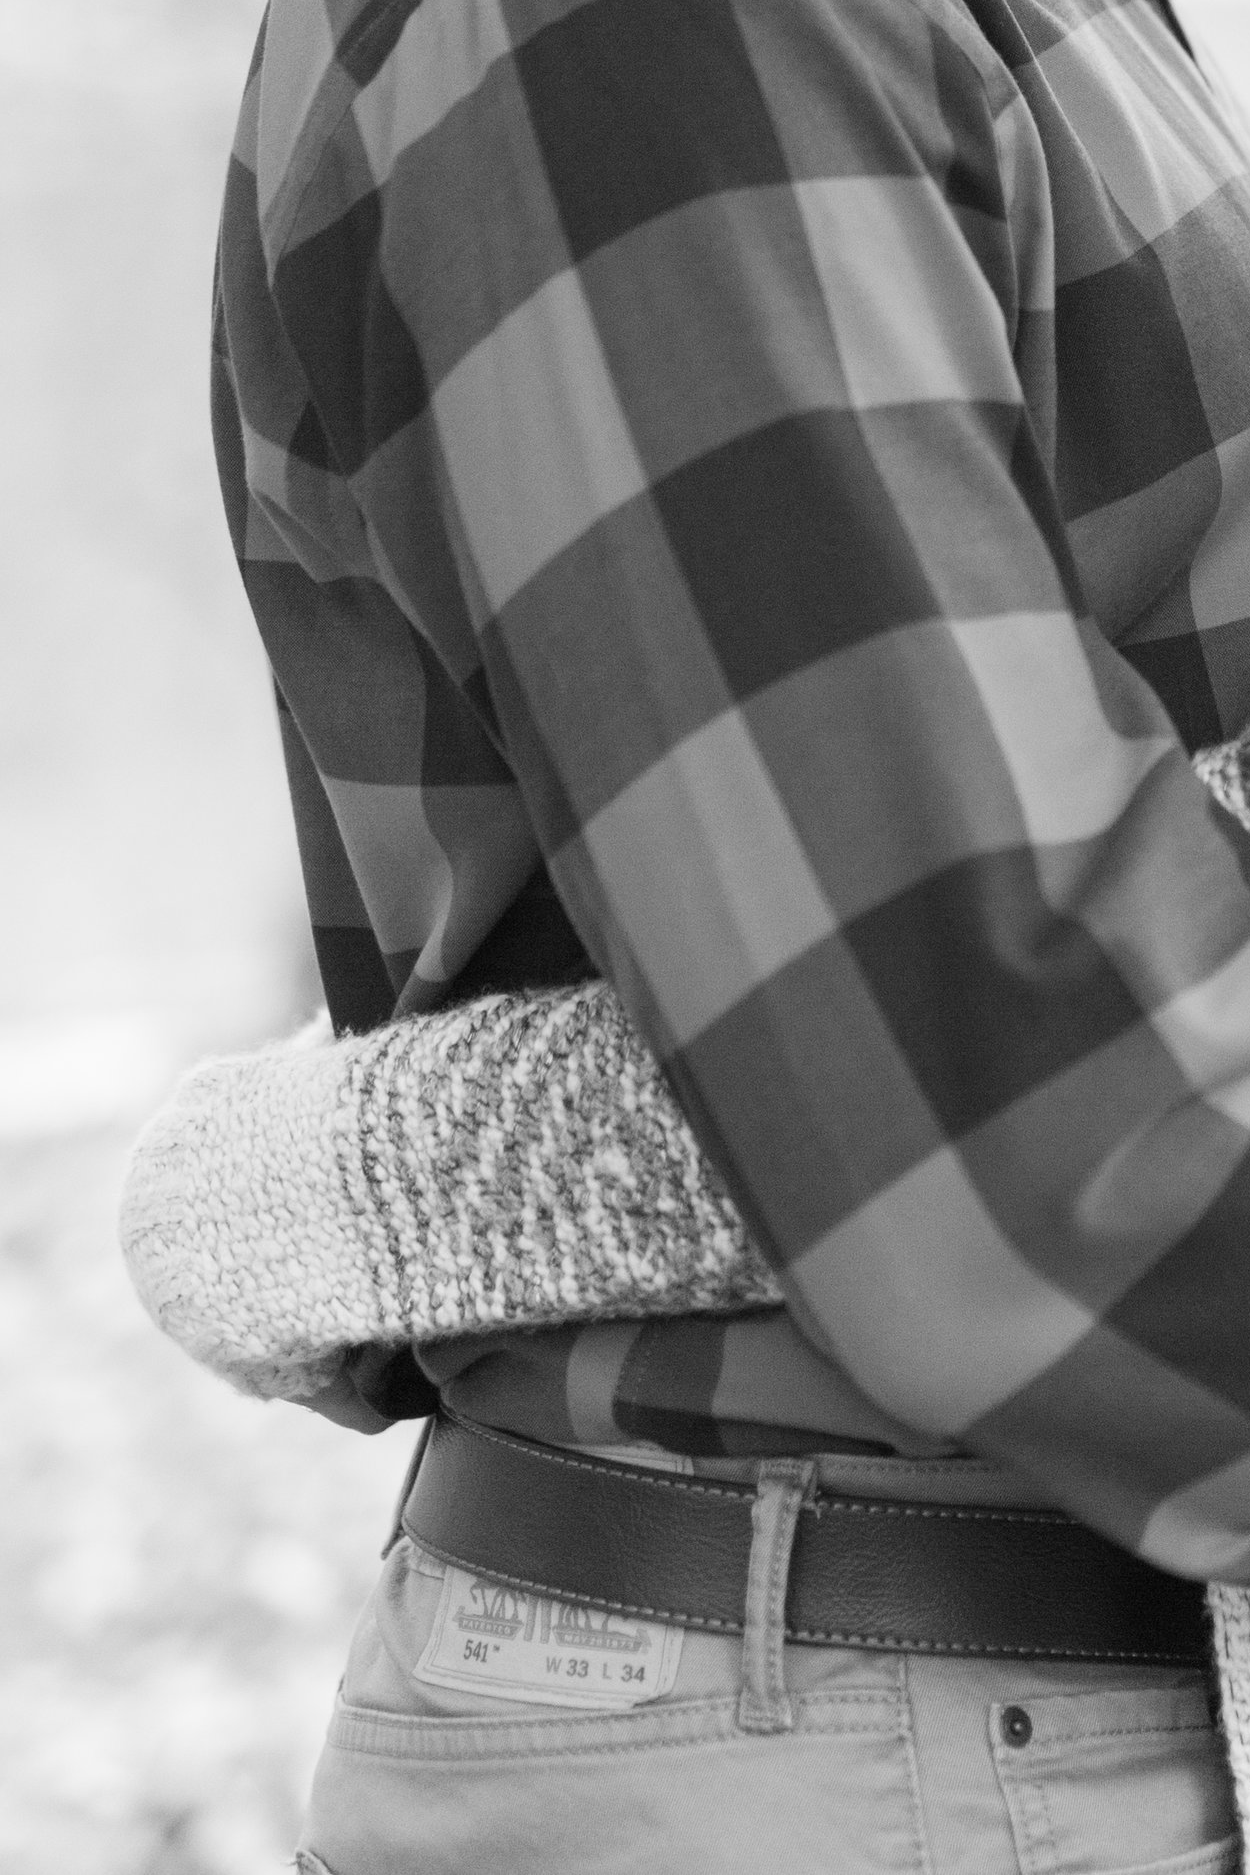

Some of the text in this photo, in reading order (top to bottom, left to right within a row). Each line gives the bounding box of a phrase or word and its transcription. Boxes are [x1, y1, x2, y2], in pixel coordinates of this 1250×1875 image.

[546, 1656, 646, 1683] W 33 L 34
